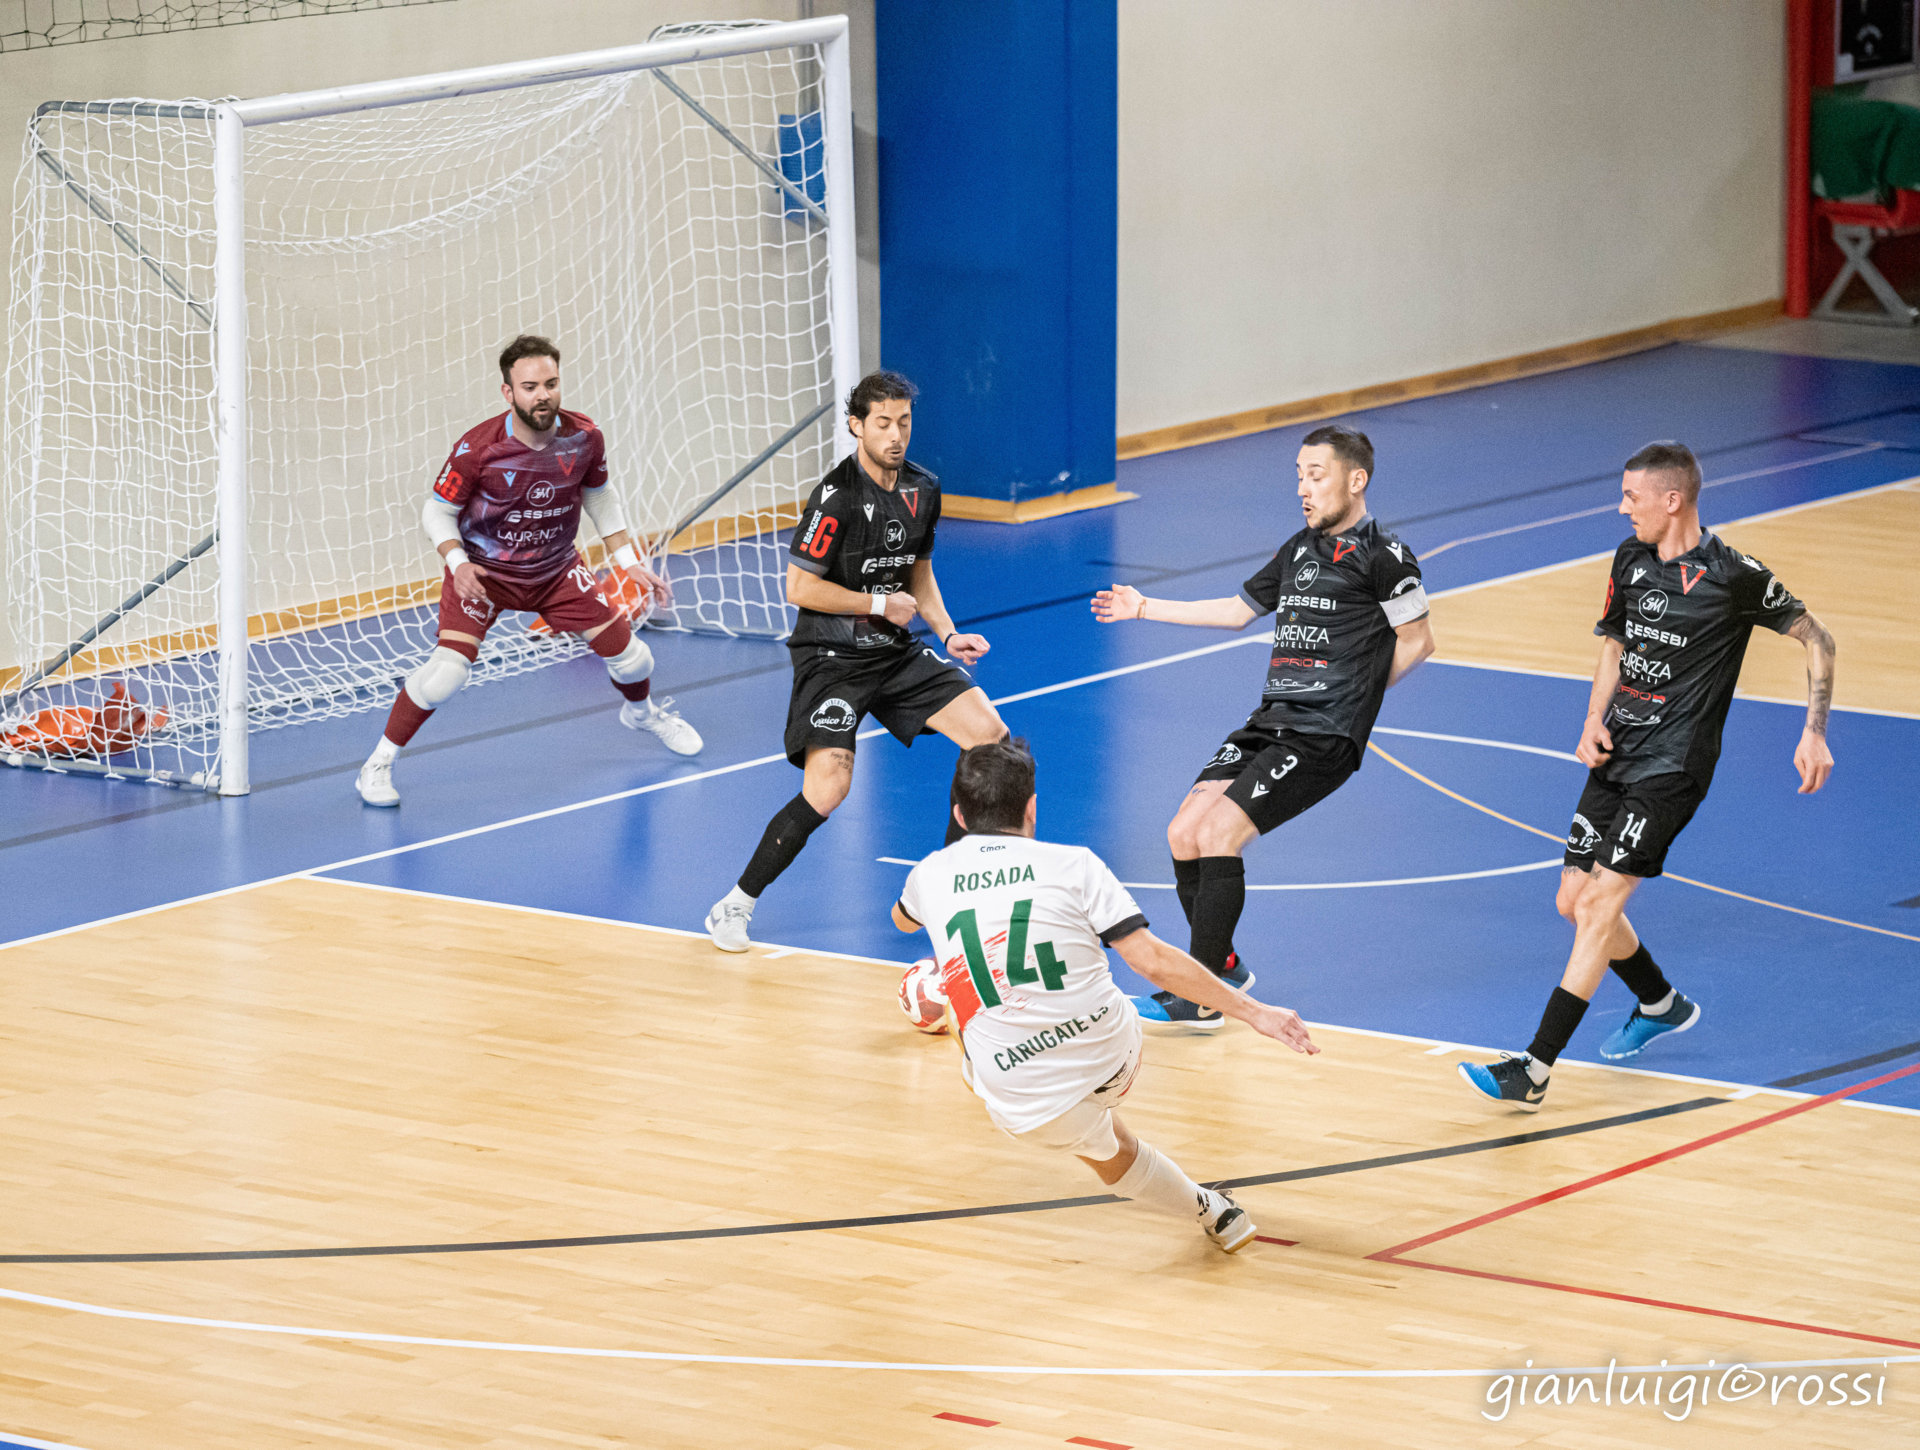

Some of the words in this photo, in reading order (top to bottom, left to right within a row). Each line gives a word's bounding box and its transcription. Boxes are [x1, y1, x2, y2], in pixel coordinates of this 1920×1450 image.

[523, 504, 574, 519] ESSEBI
[567, 564, 597, 594] 28
[1285, 595, 1337, 611] ESSEBI
[1275, 624, 1330, 645] URENZA
[1633, 624, 1688, 648] ESSEBI
[1270, 754, 1299, 780] 3
[1619, 812, 1648, 849] 14
[953, 864, 1036, 894] ROSADA
[945, 898, 1069, 1010] 14
[993, 1017, 1090, 1073] CARUGATE
